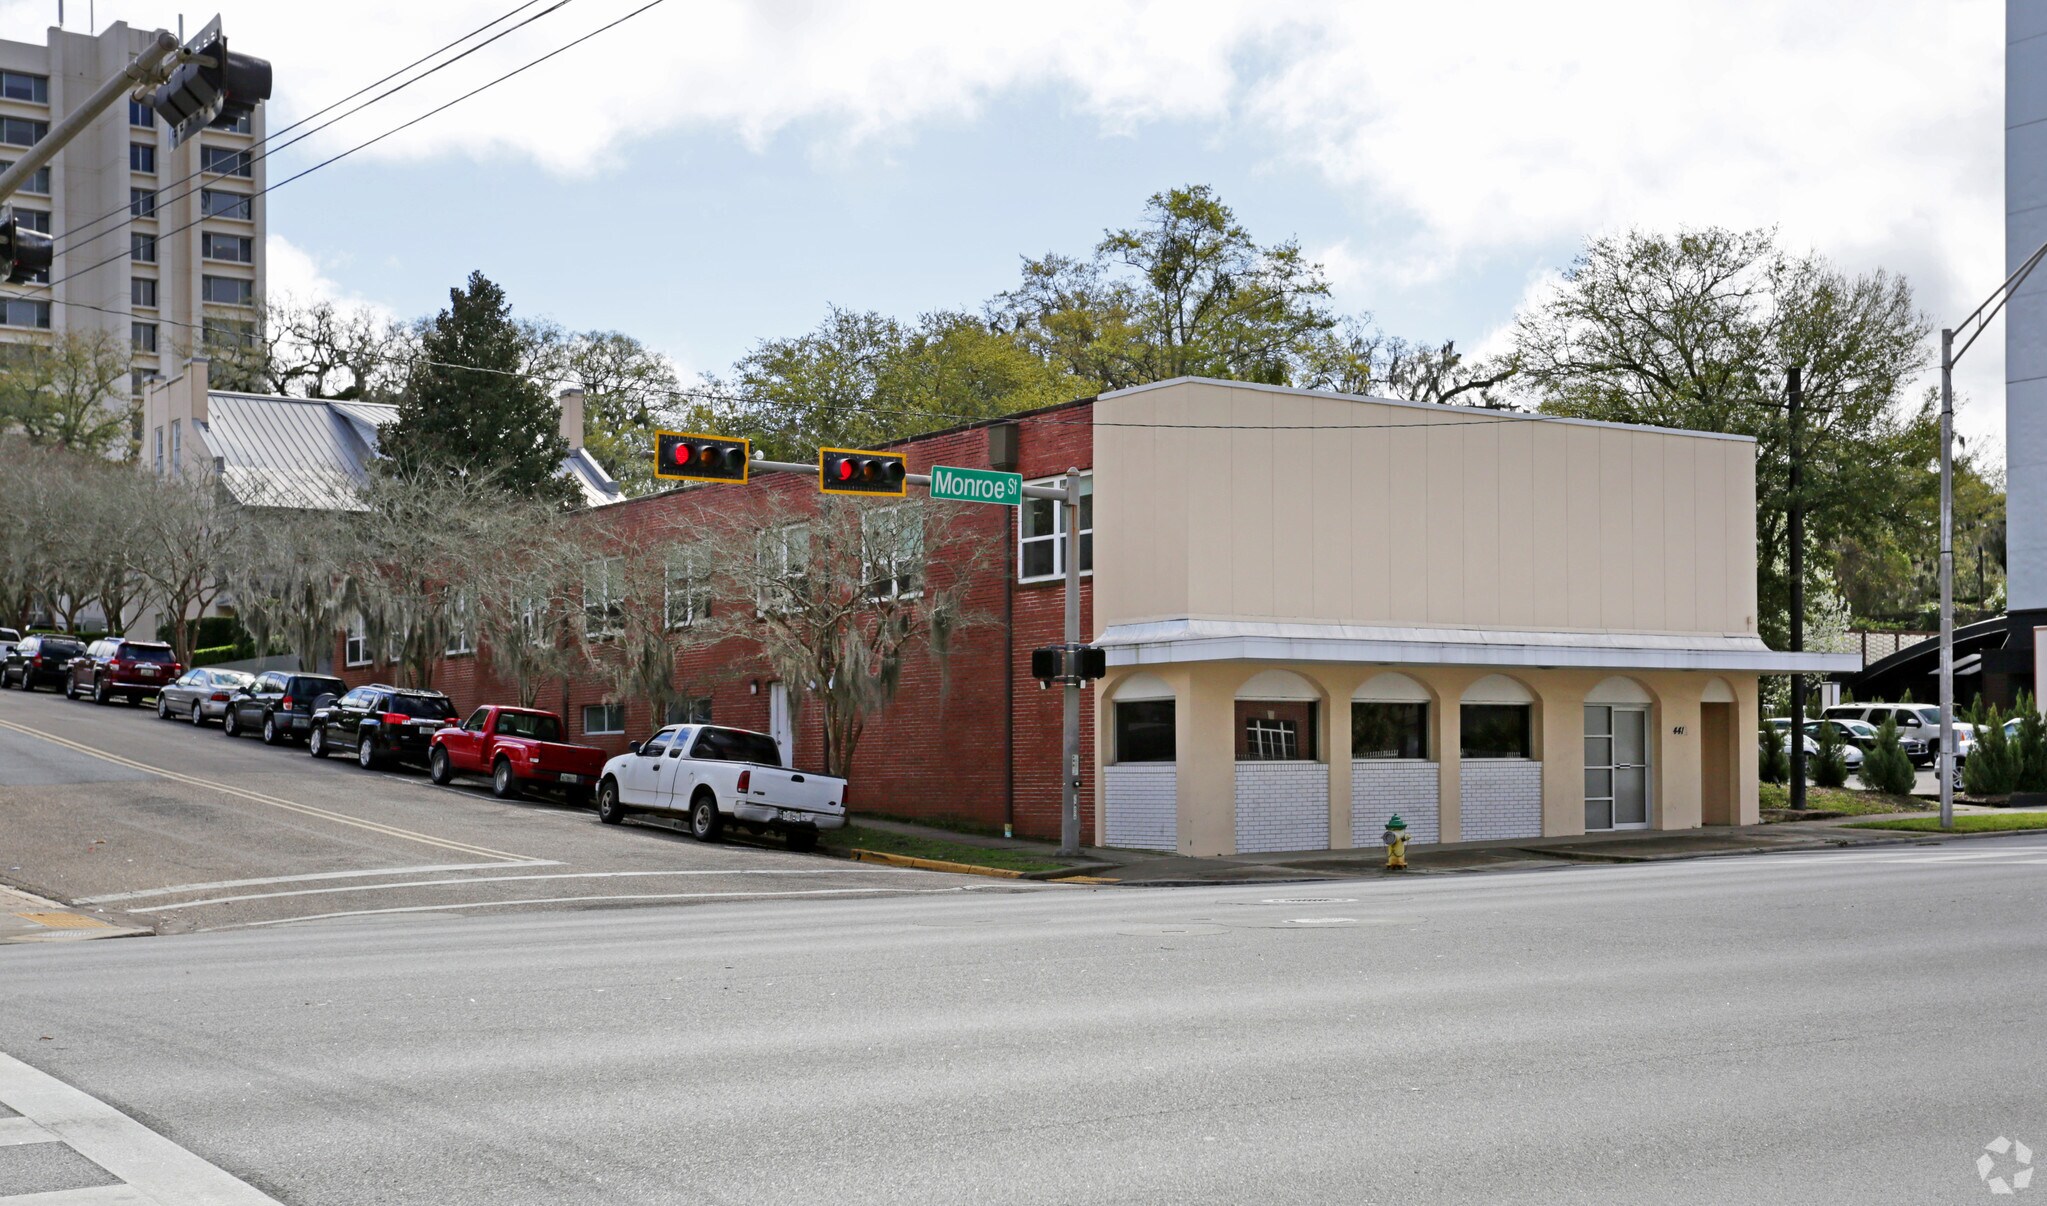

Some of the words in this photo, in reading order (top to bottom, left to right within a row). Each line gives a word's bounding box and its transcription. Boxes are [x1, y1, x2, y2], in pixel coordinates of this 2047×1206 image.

[934, 470, 1005, 499] Monroe
[1007, 477, 1018, 495] St
[1672, 726, 1685, 735] 441
